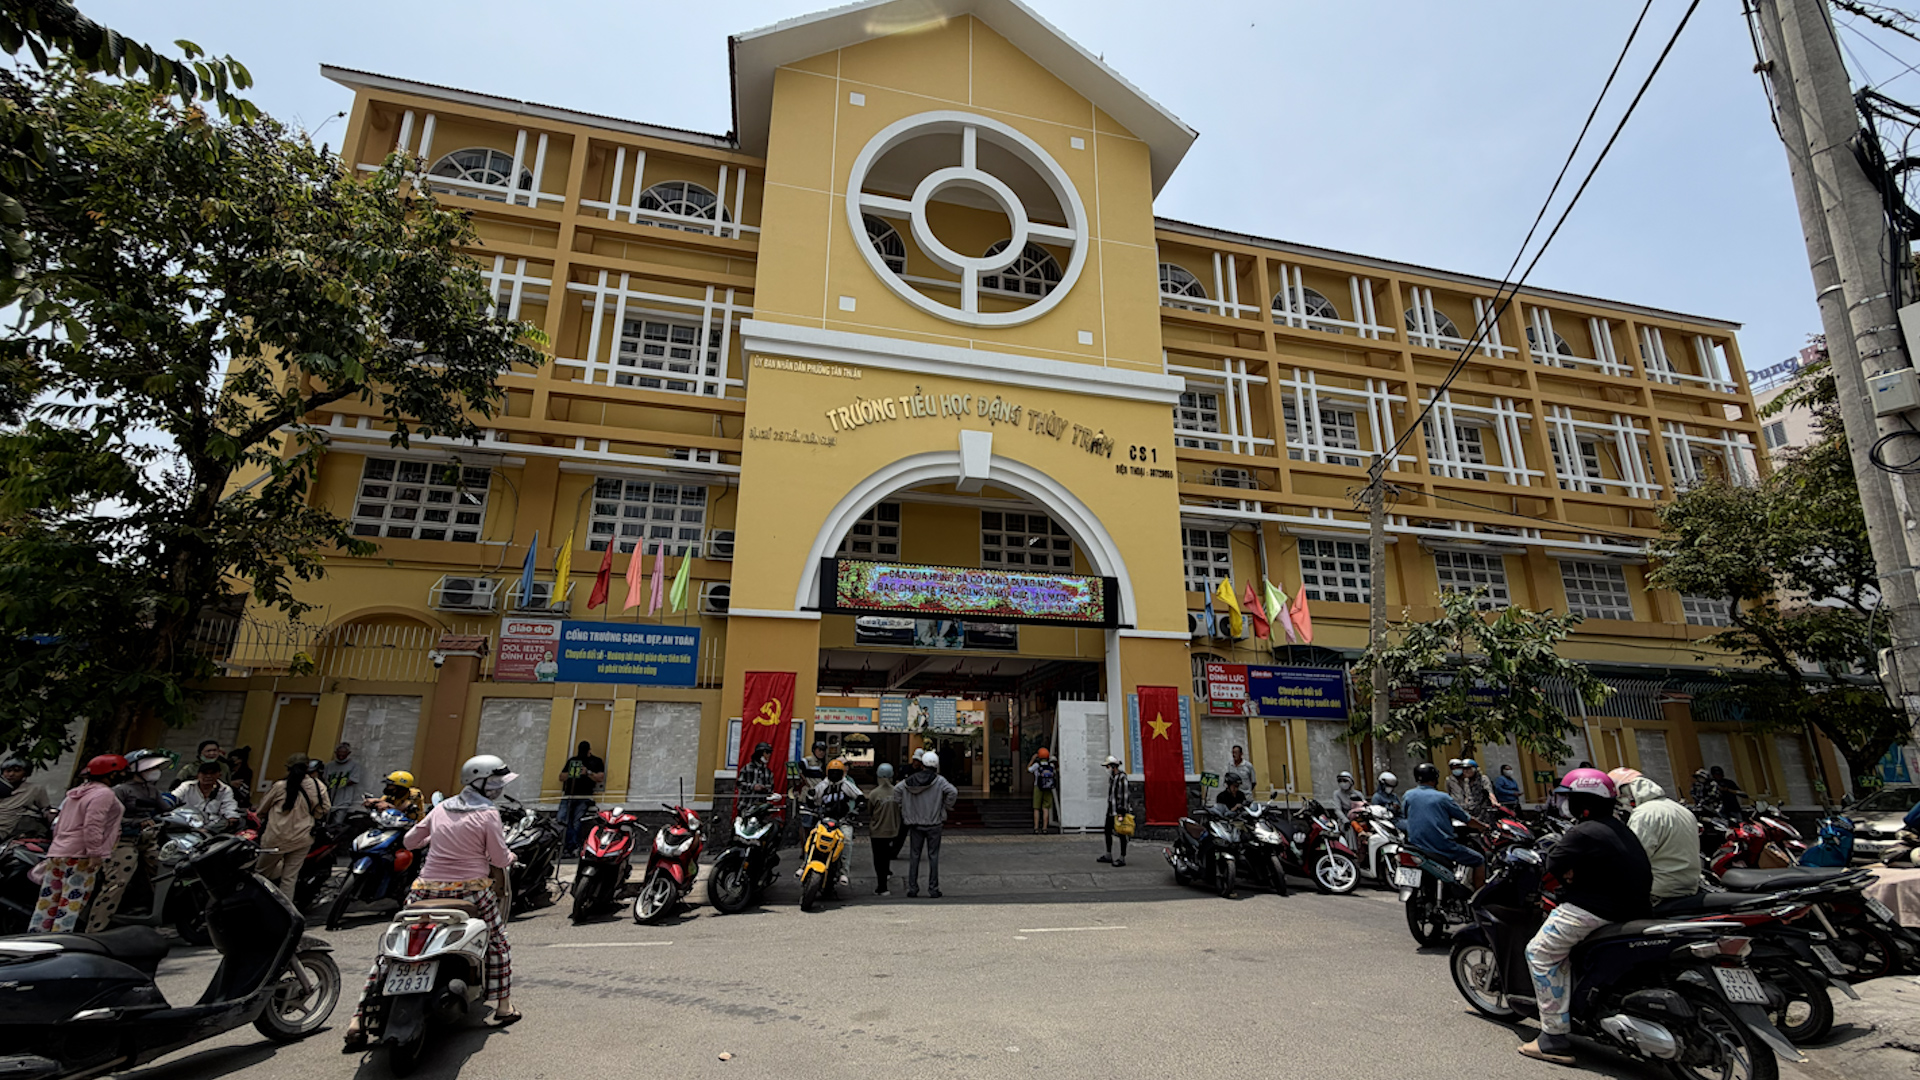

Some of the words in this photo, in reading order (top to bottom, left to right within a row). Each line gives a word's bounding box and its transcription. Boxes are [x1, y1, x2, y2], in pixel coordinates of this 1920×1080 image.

[763, 358, 775, 370] BAN
[776, 359, 793, 372] NHÂN
[794, 361, 806, 373] DÂN
[807, 362, 830, 377] PHƯỜNG
[831, 365, 842, 378] TÂN
[825, 395, 897, 433] TRƯỜNG
[898, 385, 937, 419] TIỂU
[938, 393, 972, 422] HỌC
[977, 395, 1022, 427] ĐẶNG
[1027, 409, 1068, 442] THÙY
[1071, 424, 1115, 459] TRÂM
[1129, 445, 1147, 462] CS
[1151, 448, 1157, 463] 1
[509, 624, 533, 634] giáo
[534, 625, 553, 635] dục
[565, 628, 588, 641] CỔNG
[590, 631, 621, 643] TRƯỜNG
[662, 635, 673, 645] AN
[674, 635, 695, 646] TOÀN
[502, 644, 521, 652] DOL
[523, 645, 545, 653] IELTS
[565, 648, 586, 661] Chuyển
[501, 651, 523, 661] ĐÌNH
[524, 653, 543, 662] LỰC
[1207, 664, 1225, 673] DOL
[1208, 671, 1228, 682] ĐÌNH
[1228, 673, 1245, 683] LỰC
[1278, 685, 1303, 697] Chuyển
[1261, 696, 1278, 706] Thúc
[1200, 776, 1218, 787] 4/5
[396, 962, 431, 977] 59-C2
[1720, 969, 1752, 985] 59-C2
[387, 976, 431, 993] 228.31
[1726, 984, 1765, 1001] 652.14
